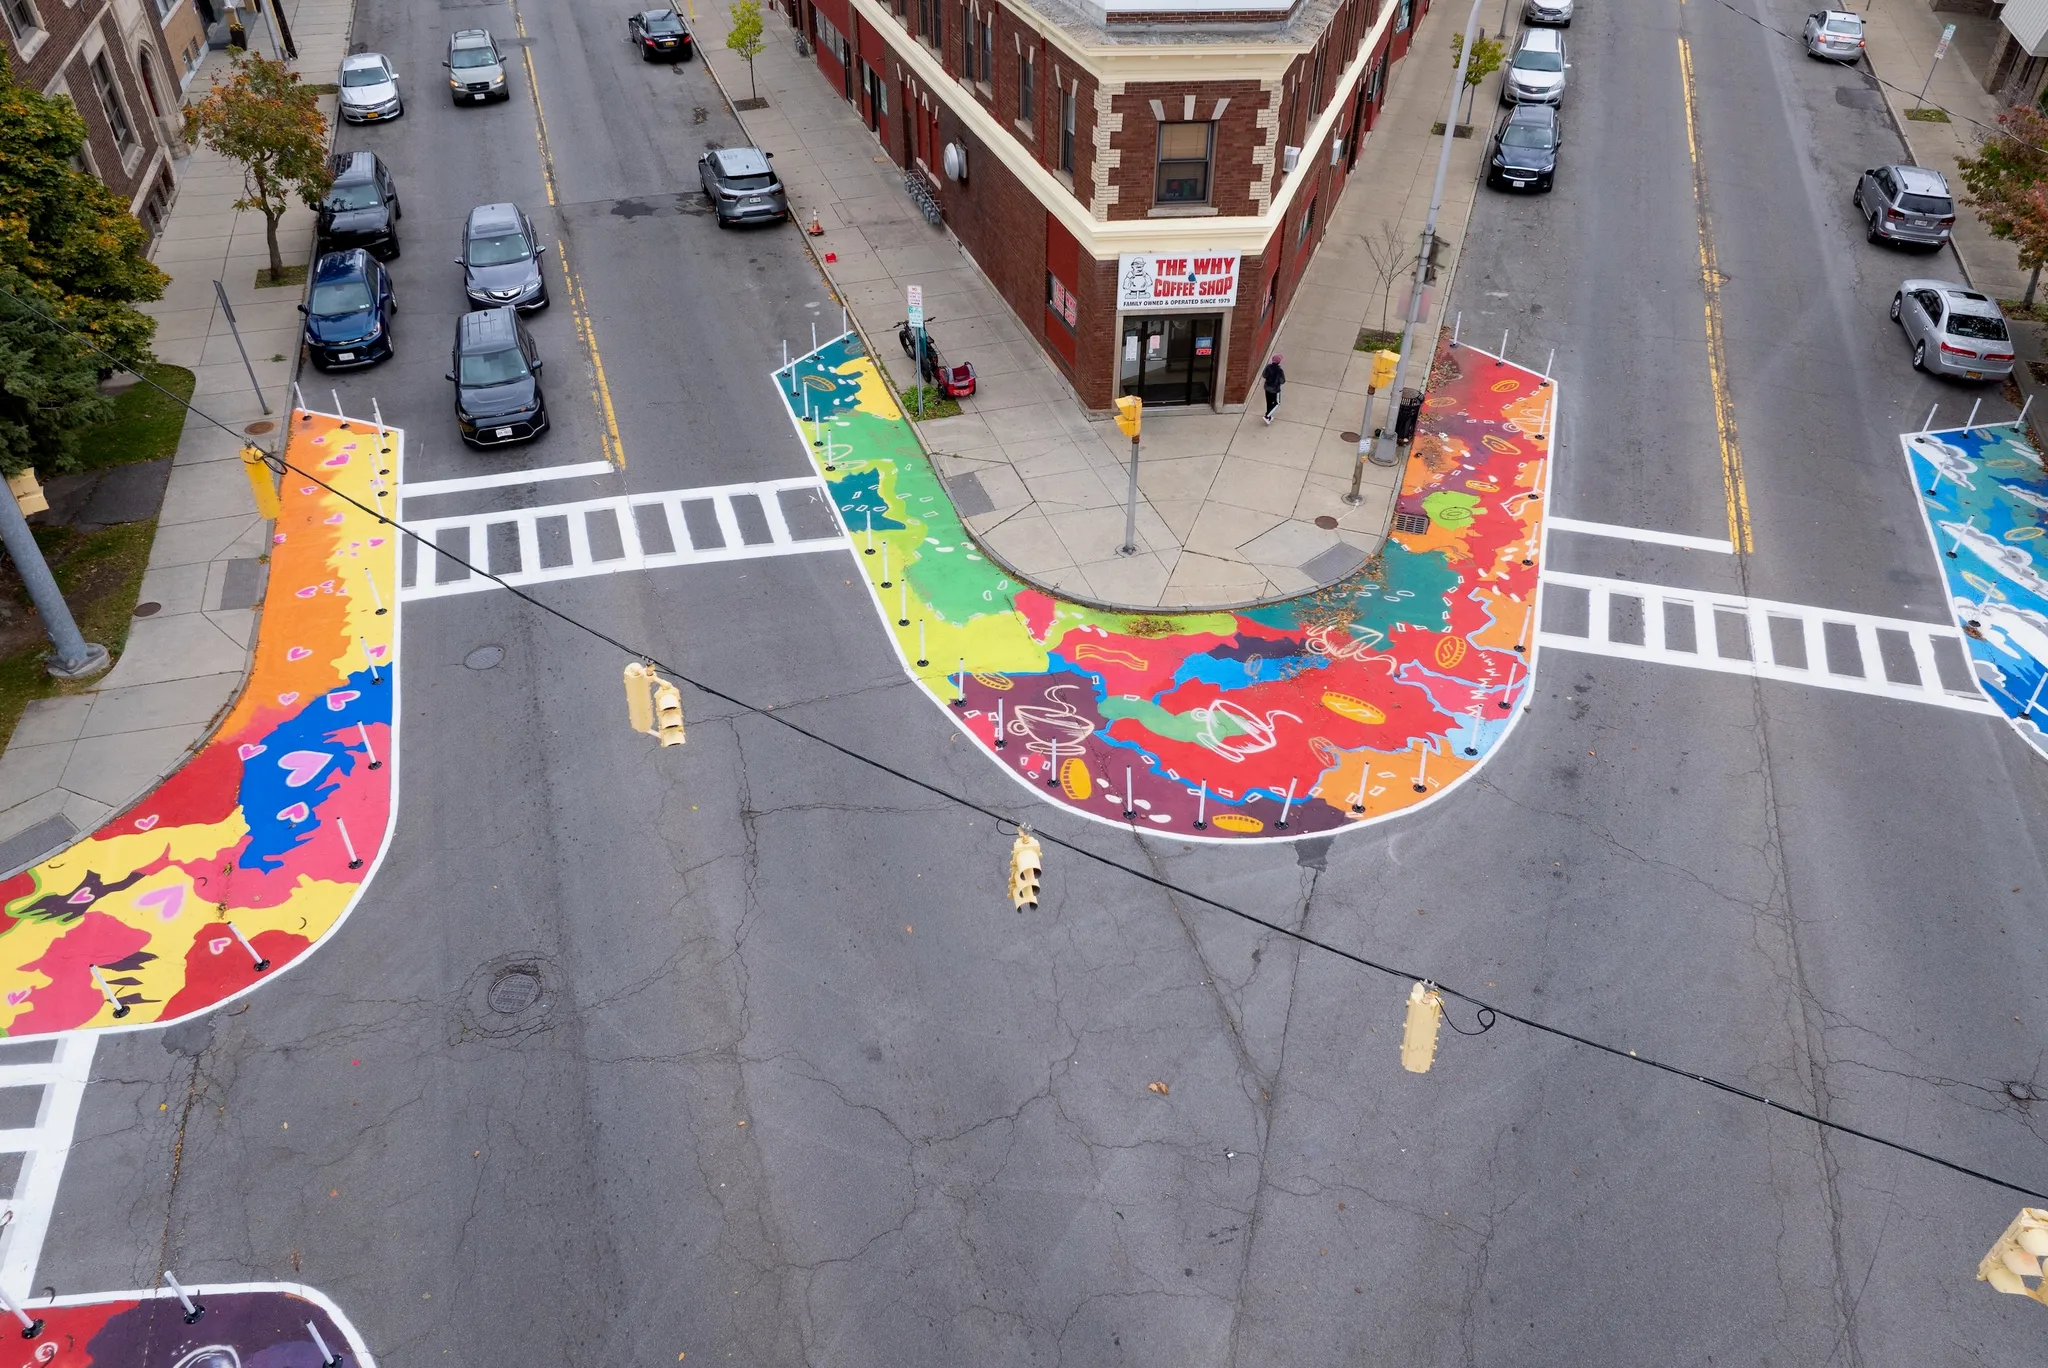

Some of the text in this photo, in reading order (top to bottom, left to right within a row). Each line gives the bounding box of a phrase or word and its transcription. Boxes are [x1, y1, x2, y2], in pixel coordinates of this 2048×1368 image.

[1156, 257, 1235, 276] THE WHY
[1154, 276, 1232, 297] COFFEE SHOP
